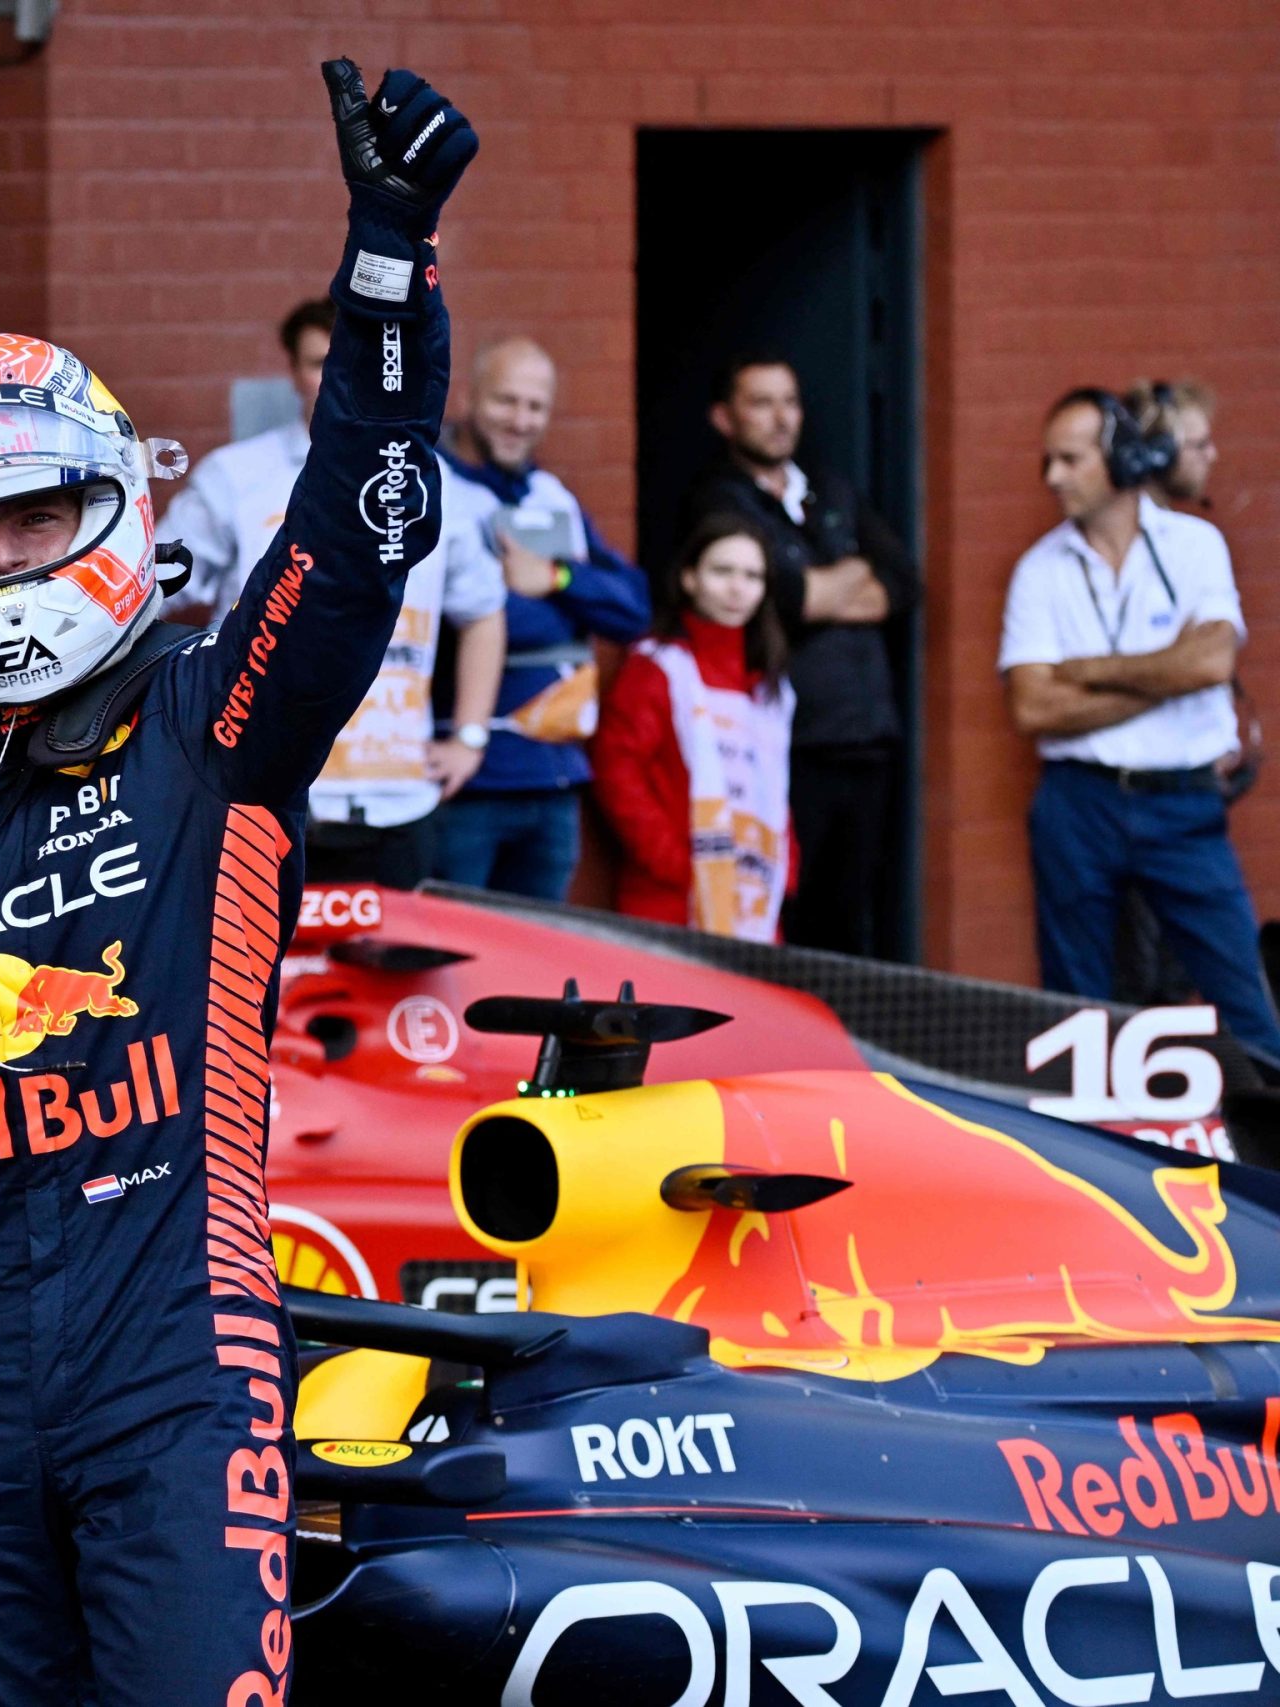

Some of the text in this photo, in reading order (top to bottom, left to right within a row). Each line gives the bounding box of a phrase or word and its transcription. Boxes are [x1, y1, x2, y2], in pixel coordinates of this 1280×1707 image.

[383, 322, 403, 392] sparc
[377, 440, 412, 503] Rock
[19, 1033, 181, 1156] Bull
[1026, 1004, 1223, 1121] 16
[120, 1161, 172, 1191] MAX
[336, 1443, 400, 1457] RAUCH
[572, 1412, 736, 1483] ROKT
[501, 1556, 1280, 1707] ORACL
